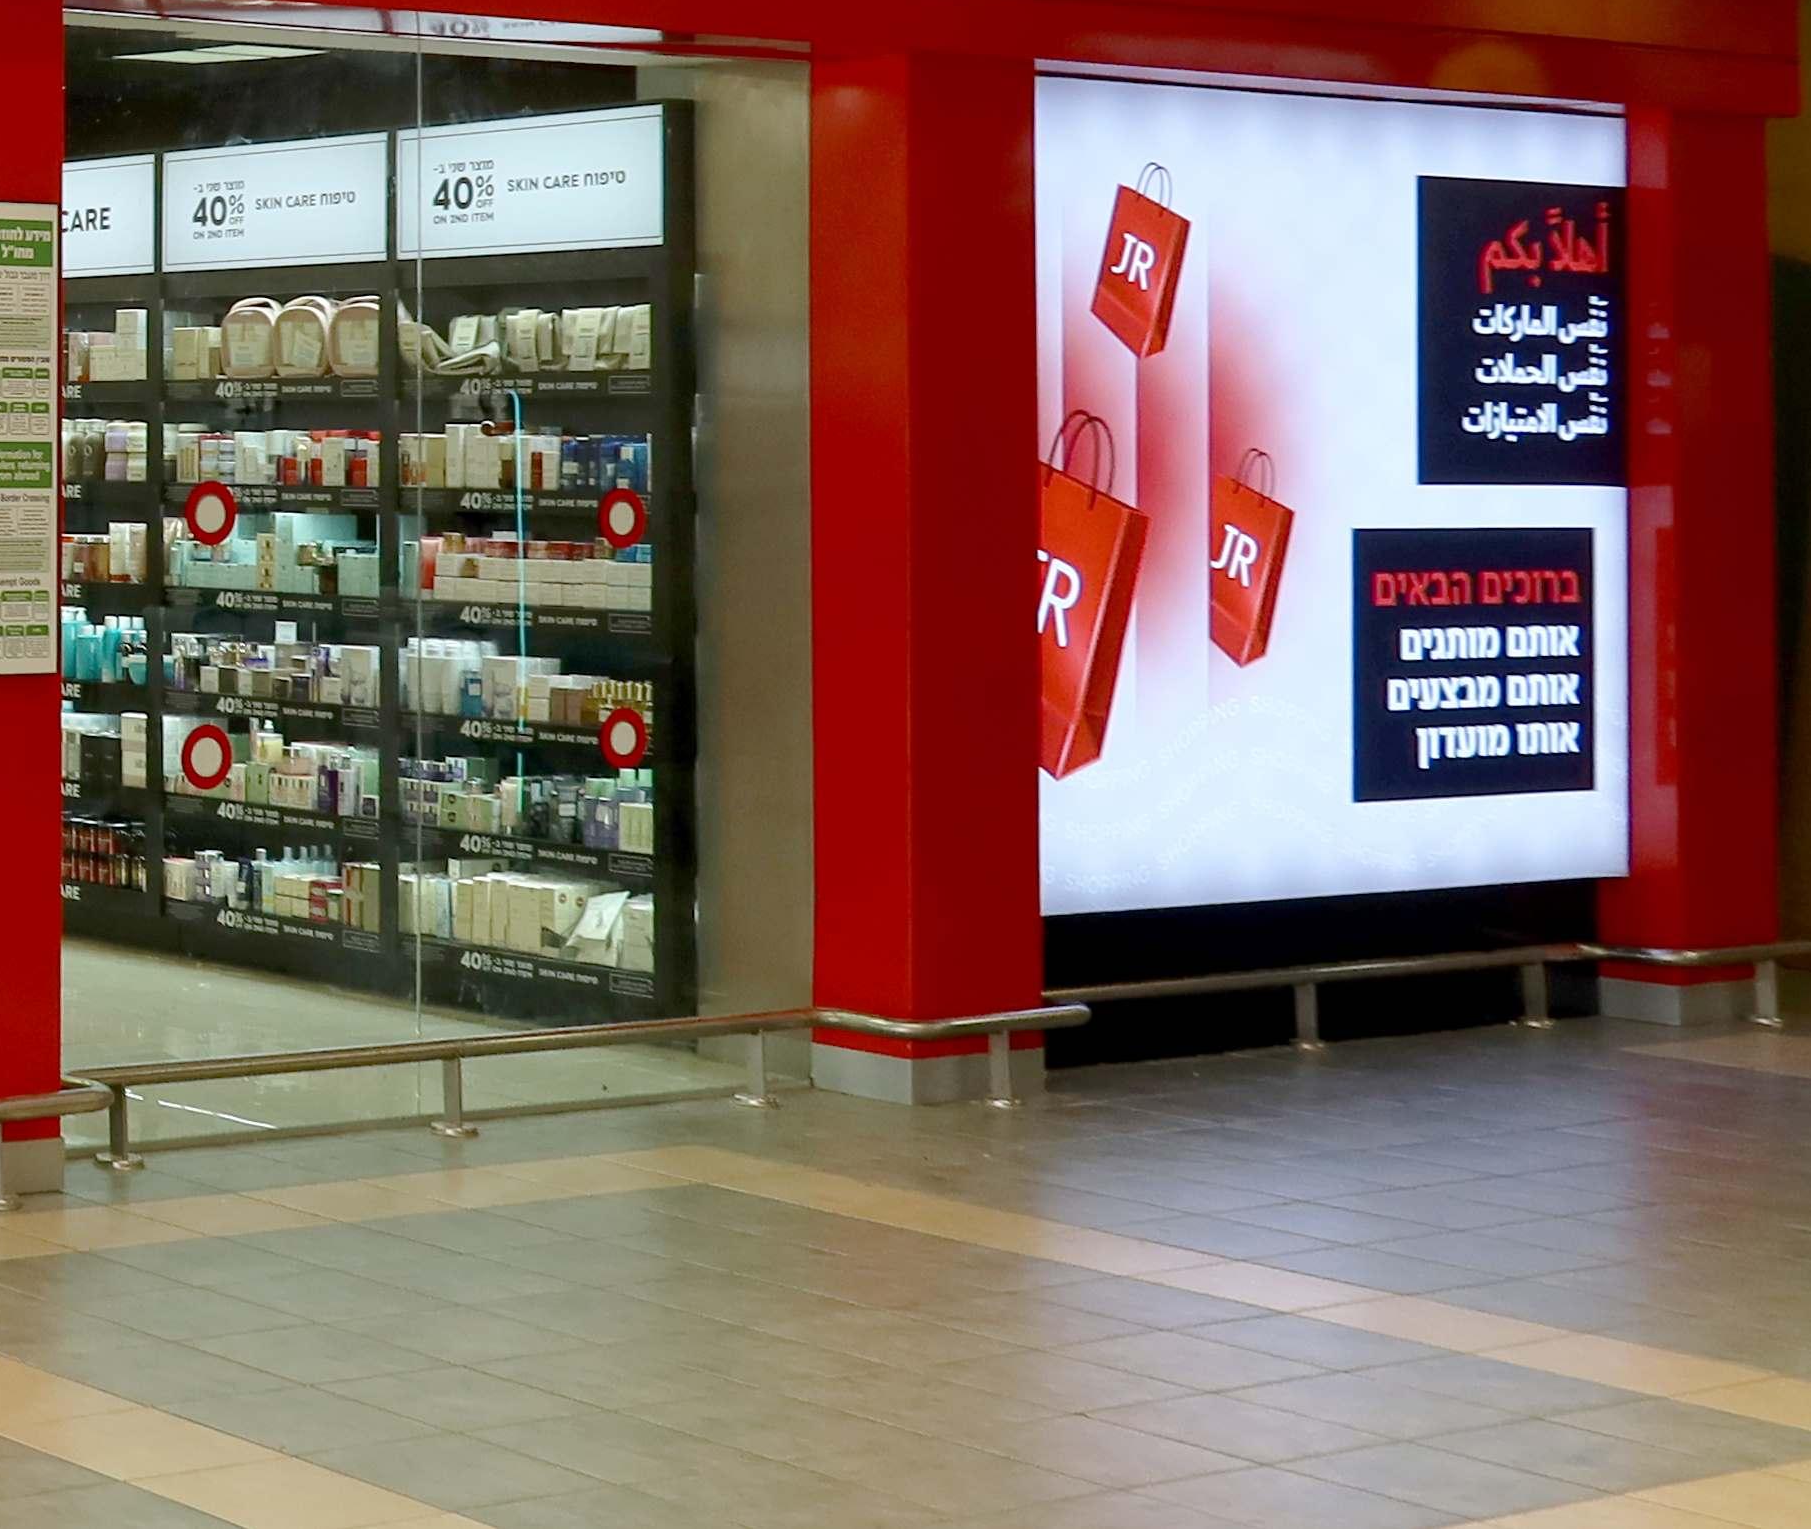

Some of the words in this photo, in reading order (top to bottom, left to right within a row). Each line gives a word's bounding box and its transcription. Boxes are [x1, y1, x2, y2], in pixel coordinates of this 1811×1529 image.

[507, 177, 539, 192] SKIN
[543, 174, 578, 190] CARE
[255, 197, 282, 211] SKIN
[285, 194, 316, 209] CARE
[1109, 232, 1156, 291] JR
[1478, 219, 1544, 294] بكم
[0, 493, 21, 502] Border
[1210, 523, 1260, 588] JR
[18, 577, 41, 587] Goods
[1037, 549, 1082, 648] R
[1371, 570, 1473, 607] הבאים
[1481, 569, 1581, 606] ברוכים
[1399, 626, 1501, 662] מותגים
[1506, 624, 1581, 659] אותם
[1387, 675, 1501, 711] מבצעים
[1506, 674, 1581, 708] אותם
[1416, 723, 1510, 770] מועדון
[1516, 721, 1581, 755] אותו
